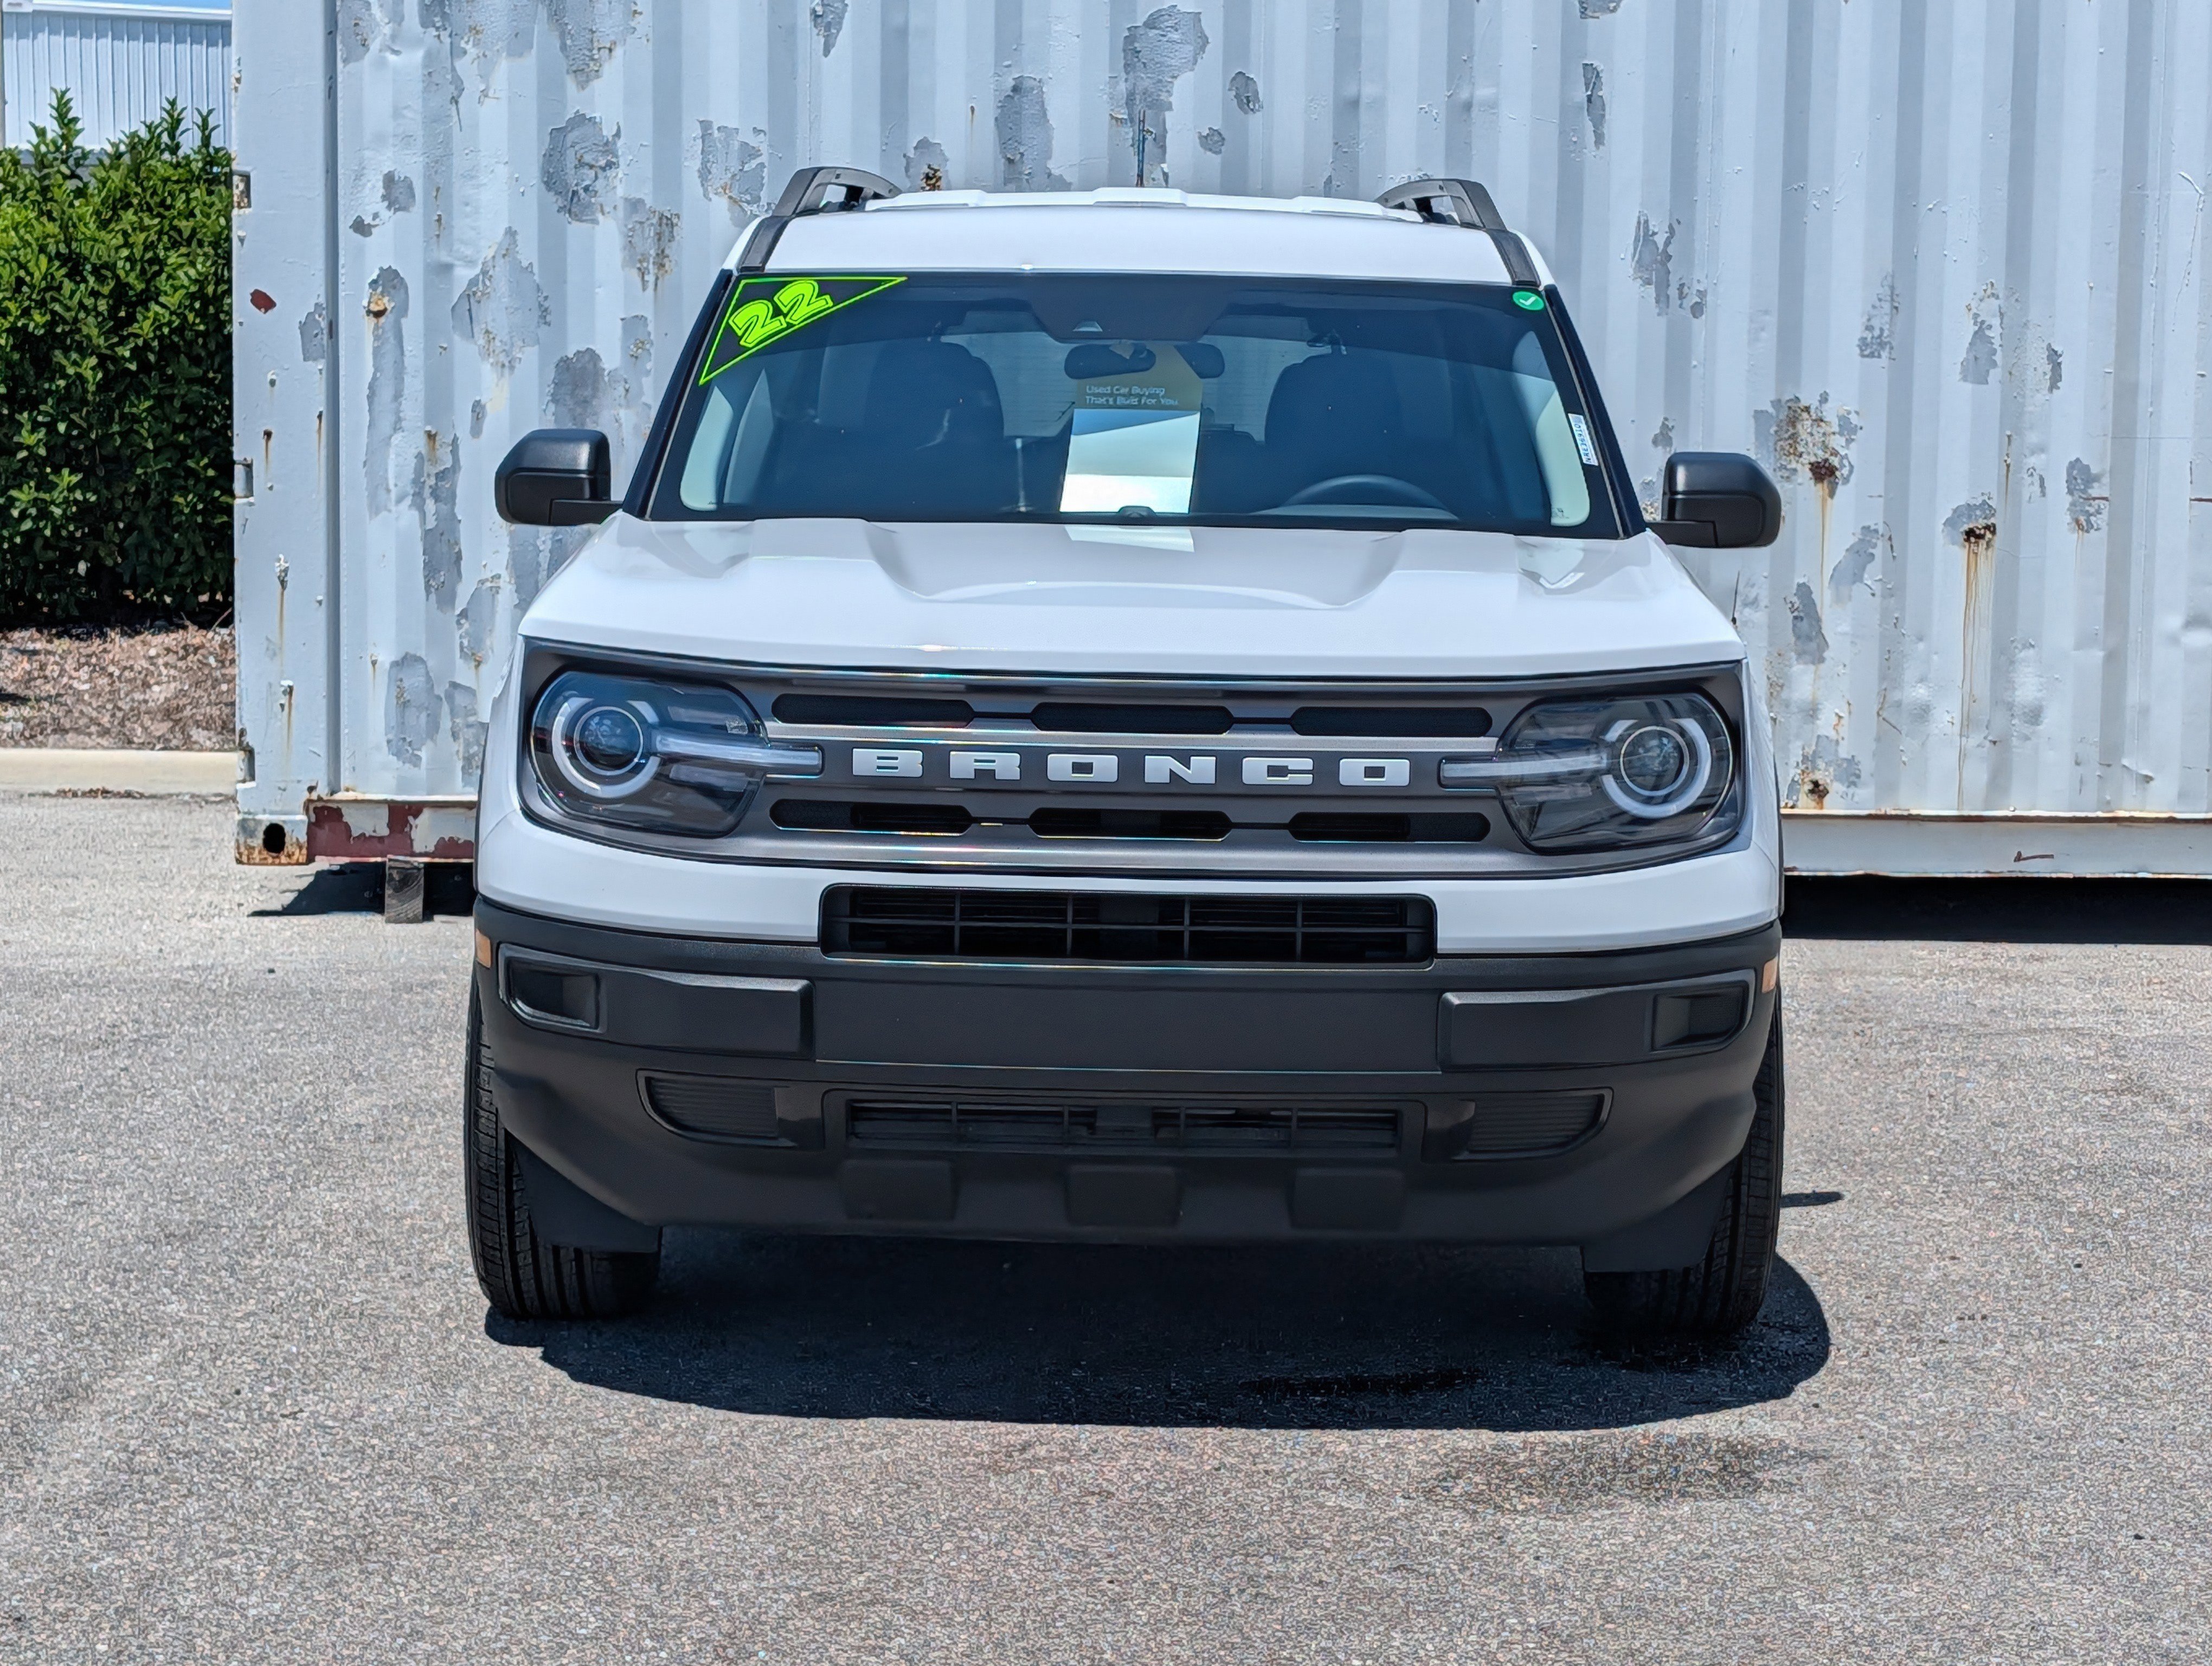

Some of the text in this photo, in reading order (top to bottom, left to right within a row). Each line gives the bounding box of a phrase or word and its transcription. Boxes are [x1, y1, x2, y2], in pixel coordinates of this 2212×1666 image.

[729, 279, 833, 348] 22
[1085, 396, 1113, 405] That's
[1116, 396, 1138, 405] Built
[1086, 385, 1165, 396] Used Car Buying
[852, 748, 1410, 786] BRONCO
